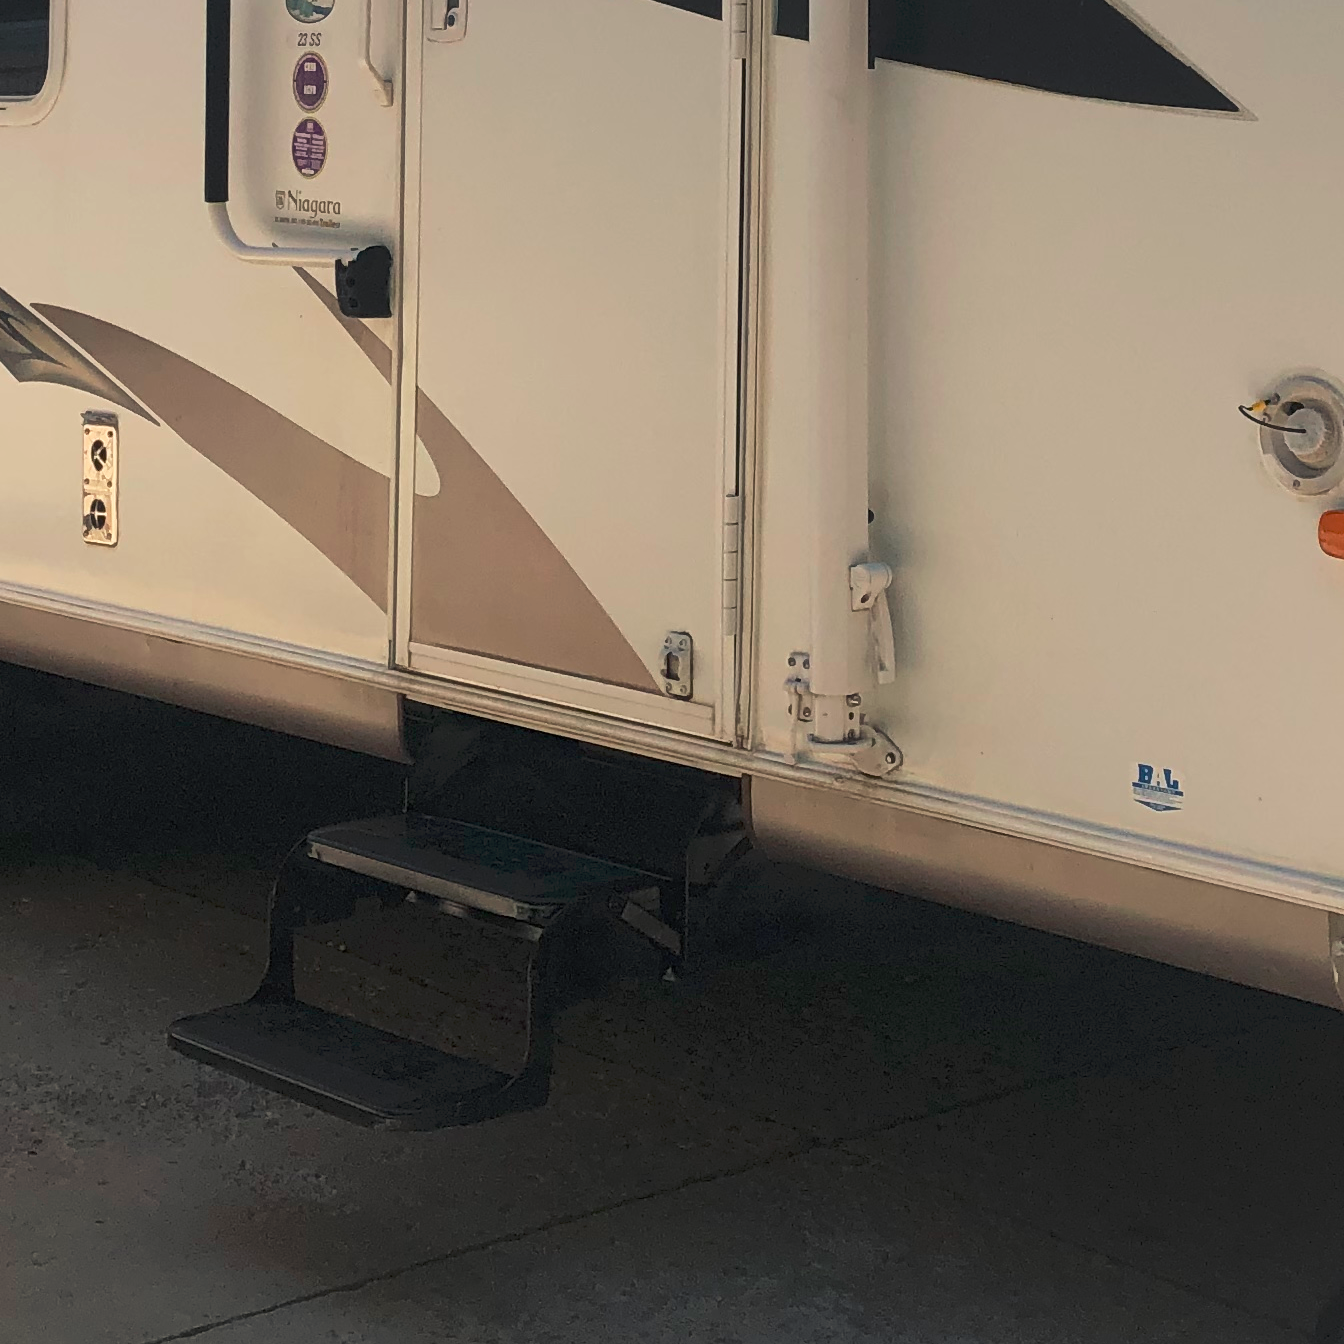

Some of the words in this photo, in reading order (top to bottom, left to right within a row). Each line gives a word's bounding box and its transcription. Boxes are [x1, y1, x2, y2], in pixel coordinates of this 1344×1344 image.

[297, 32, 308, 47] 23
[309, 32, 322, 47] SS
[287, 189, 341, 219] Niagara
